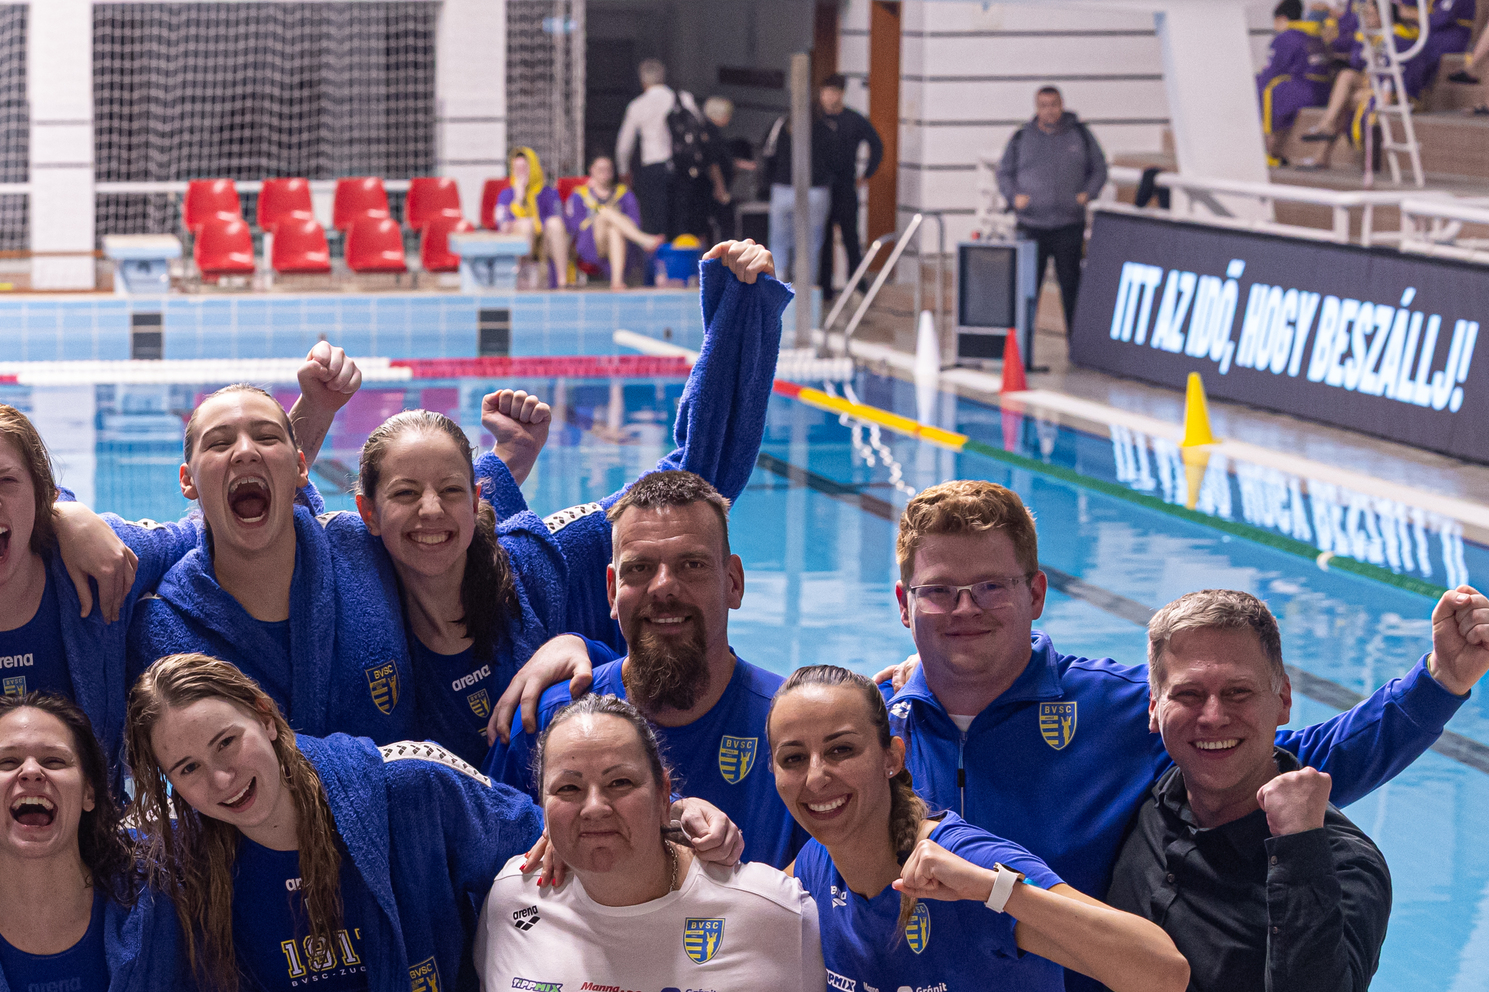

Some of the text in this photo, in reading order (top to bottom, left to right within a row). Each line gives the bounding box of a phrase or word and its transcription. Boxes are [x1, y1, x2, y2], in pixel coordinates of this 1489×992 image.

[1109, 261, 1163, 345] ITT
[1149, 269, 1198, 354] AZ
[1235, 283, 1321, 377] HOGY
[1306, 286, 1480, 413] BESZÁLLJ!
[373, 664, 394, 679] BVSC
[452, 664, 491, 692] arena
[1044, 705, 1072, 714] BVSC
[726, 739, 753, 749] BVSC
[512, 905, 539, 920] arena
[691, 921, 719, 930] BVSC
[409, 964, 433, 979] BVSC
